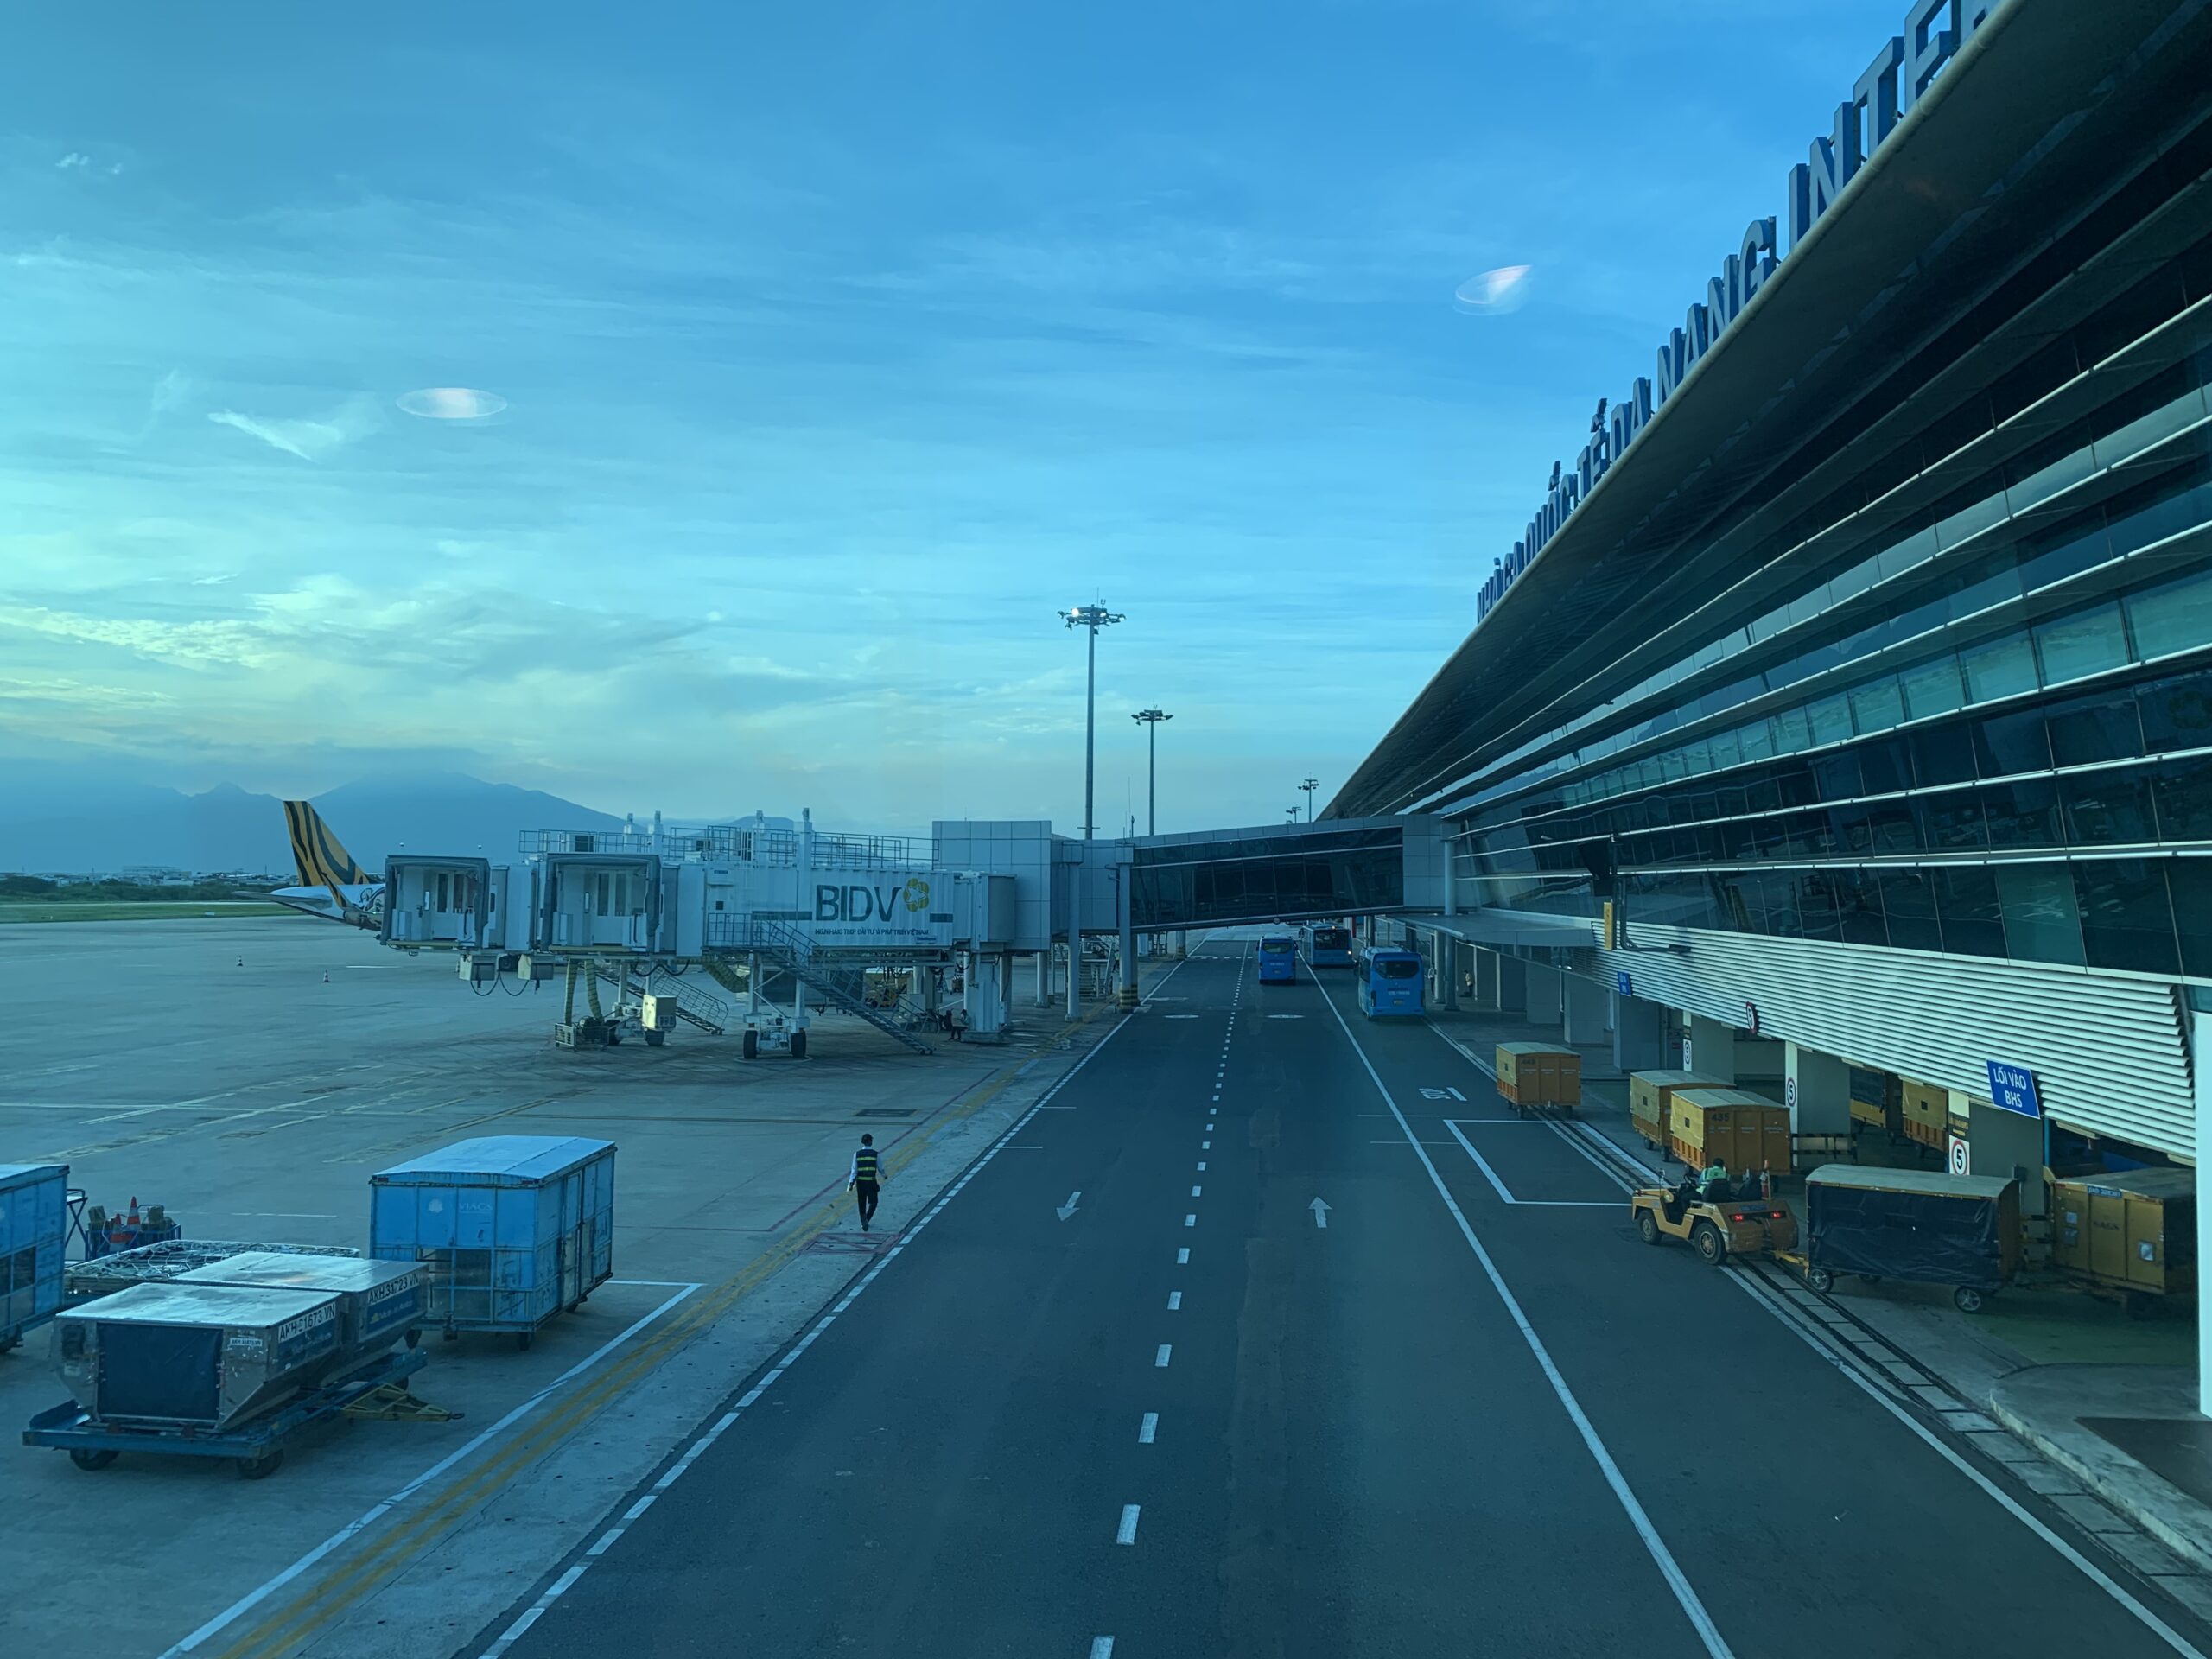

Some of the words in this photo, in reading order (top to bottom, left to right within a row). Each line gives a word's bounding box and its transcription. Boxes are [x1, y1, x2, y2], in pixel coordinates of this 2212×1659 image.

[816, 884, 902, 922] BIDV
[1993, 1065, 2009, 1085] LỐI
[2008, 1069, 2027, 1090] VÀO
[1789, 1084, 1794, 1101] 5
[2004, 1090, 2023, 1108] BHS
[1955, 1148, 1963, 1170] 5
[368, 1287, 385, 1305] AKH
[409, 1272, 420, 1287] VN
[279, 1320, 297, 1342] AKH
[324, 1302, 336, 1322] VN
